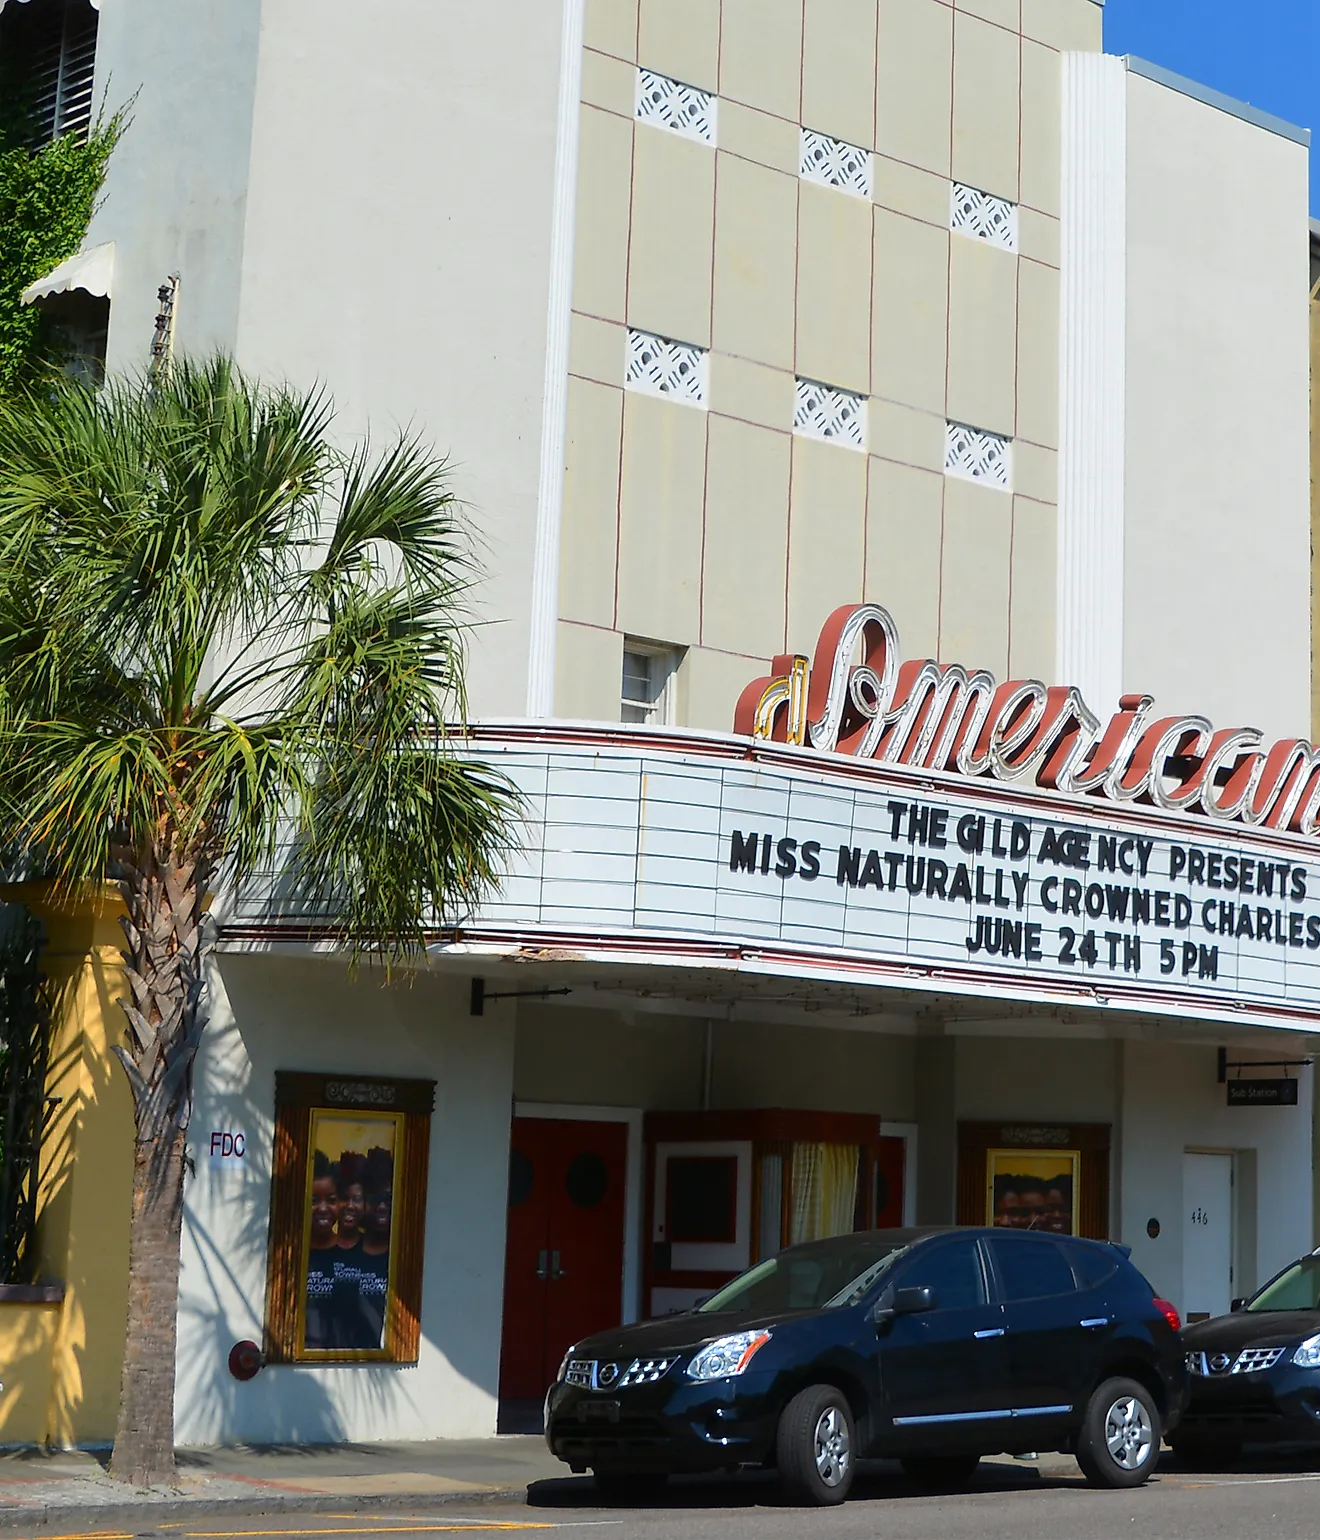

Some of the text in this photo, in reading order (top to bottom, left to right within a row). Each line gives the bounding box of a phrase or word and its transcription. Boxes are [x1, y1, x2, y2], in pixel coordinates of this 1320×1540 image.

[730, 830, 821, 881] MISS
[836, 845, 1029, 912] NATURALLY
[1040, 876, 1192, 930] CROWNED
[887, 800, 1307, 903] THE GILD AGENCY PRESENTS
[965, 915, 1219, 981] JUNE 24TH 5PM
[210, 1132, 245, 1157] FDC
[1191, 1211, 1208, 1225] 446
